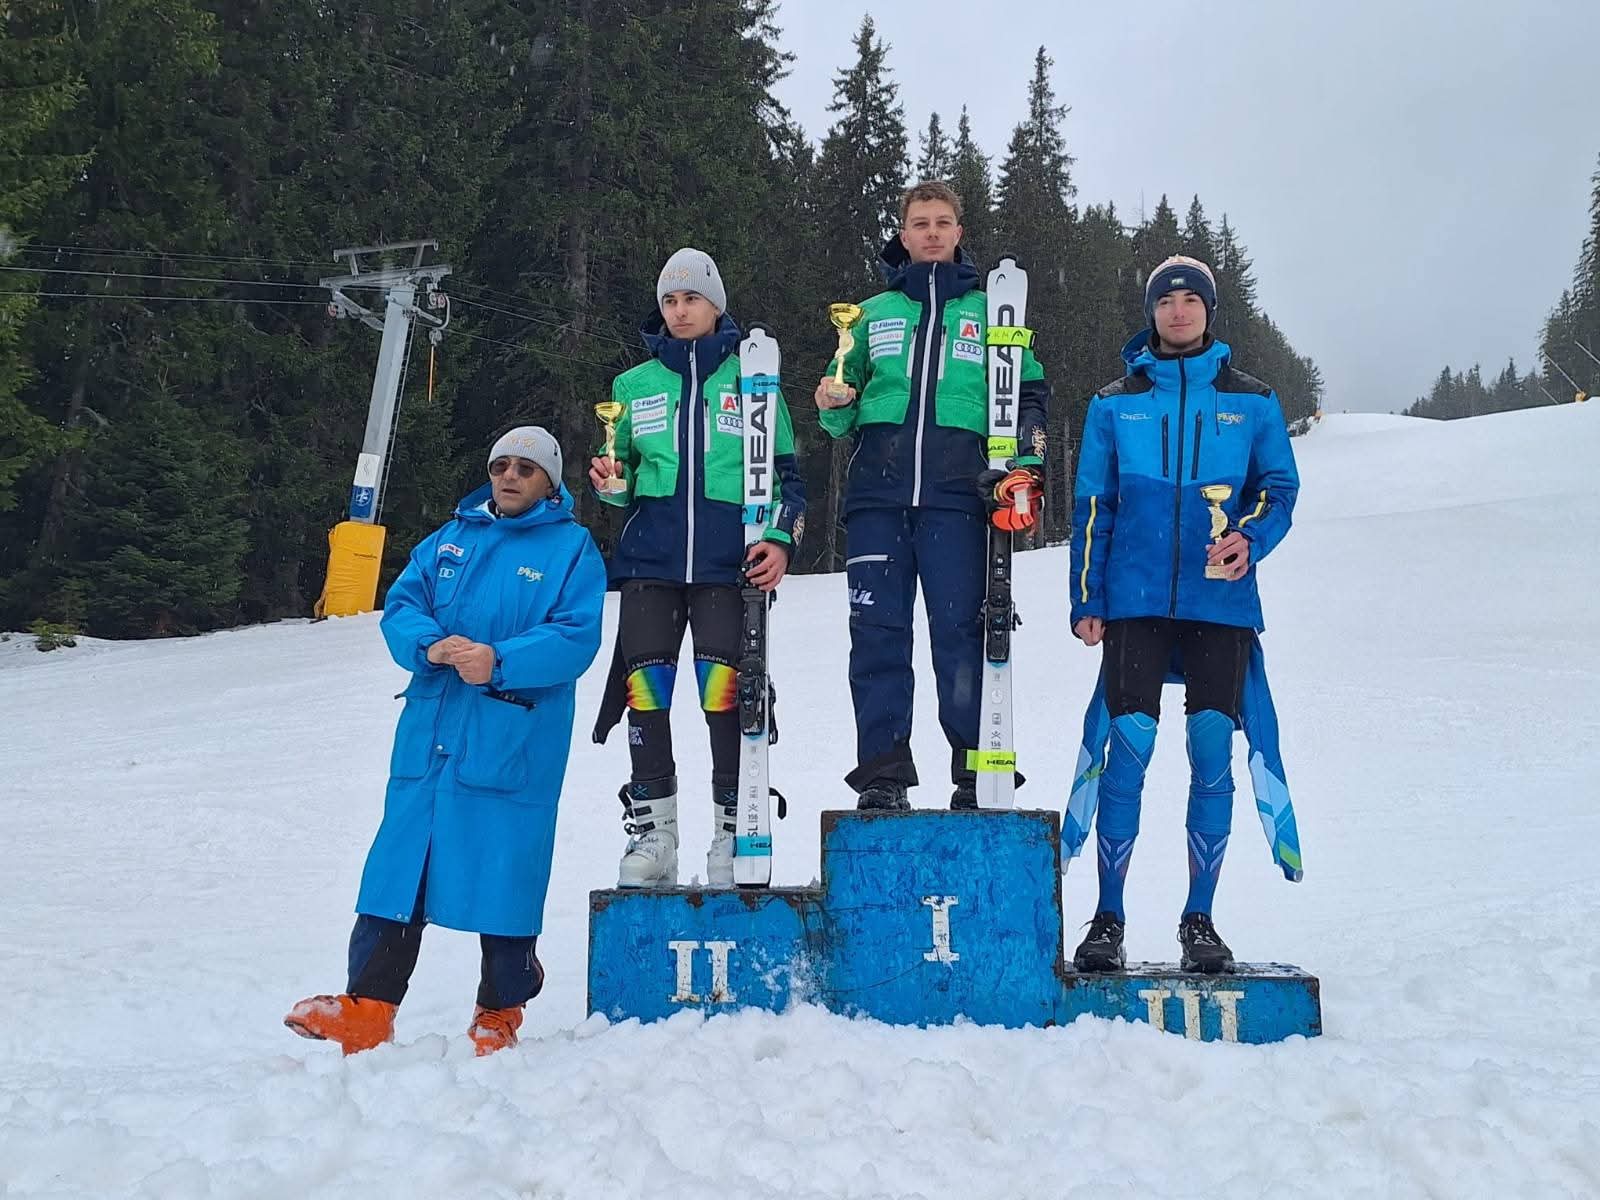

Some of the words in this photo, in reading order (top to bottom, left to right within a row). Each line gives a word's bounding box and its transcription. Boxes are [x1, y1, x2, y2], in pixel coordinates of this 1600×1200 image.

[961, 323, 979, 338] A1
[994, 304, 1015, 427] HEAD
[641, 396, 666, 406] Fibank
[722, 395, 739, 411] A1
[921, 895, 960, 963] I
[667, 940, 737, 1003] II
[1137, 989, 1245, 1042] III
